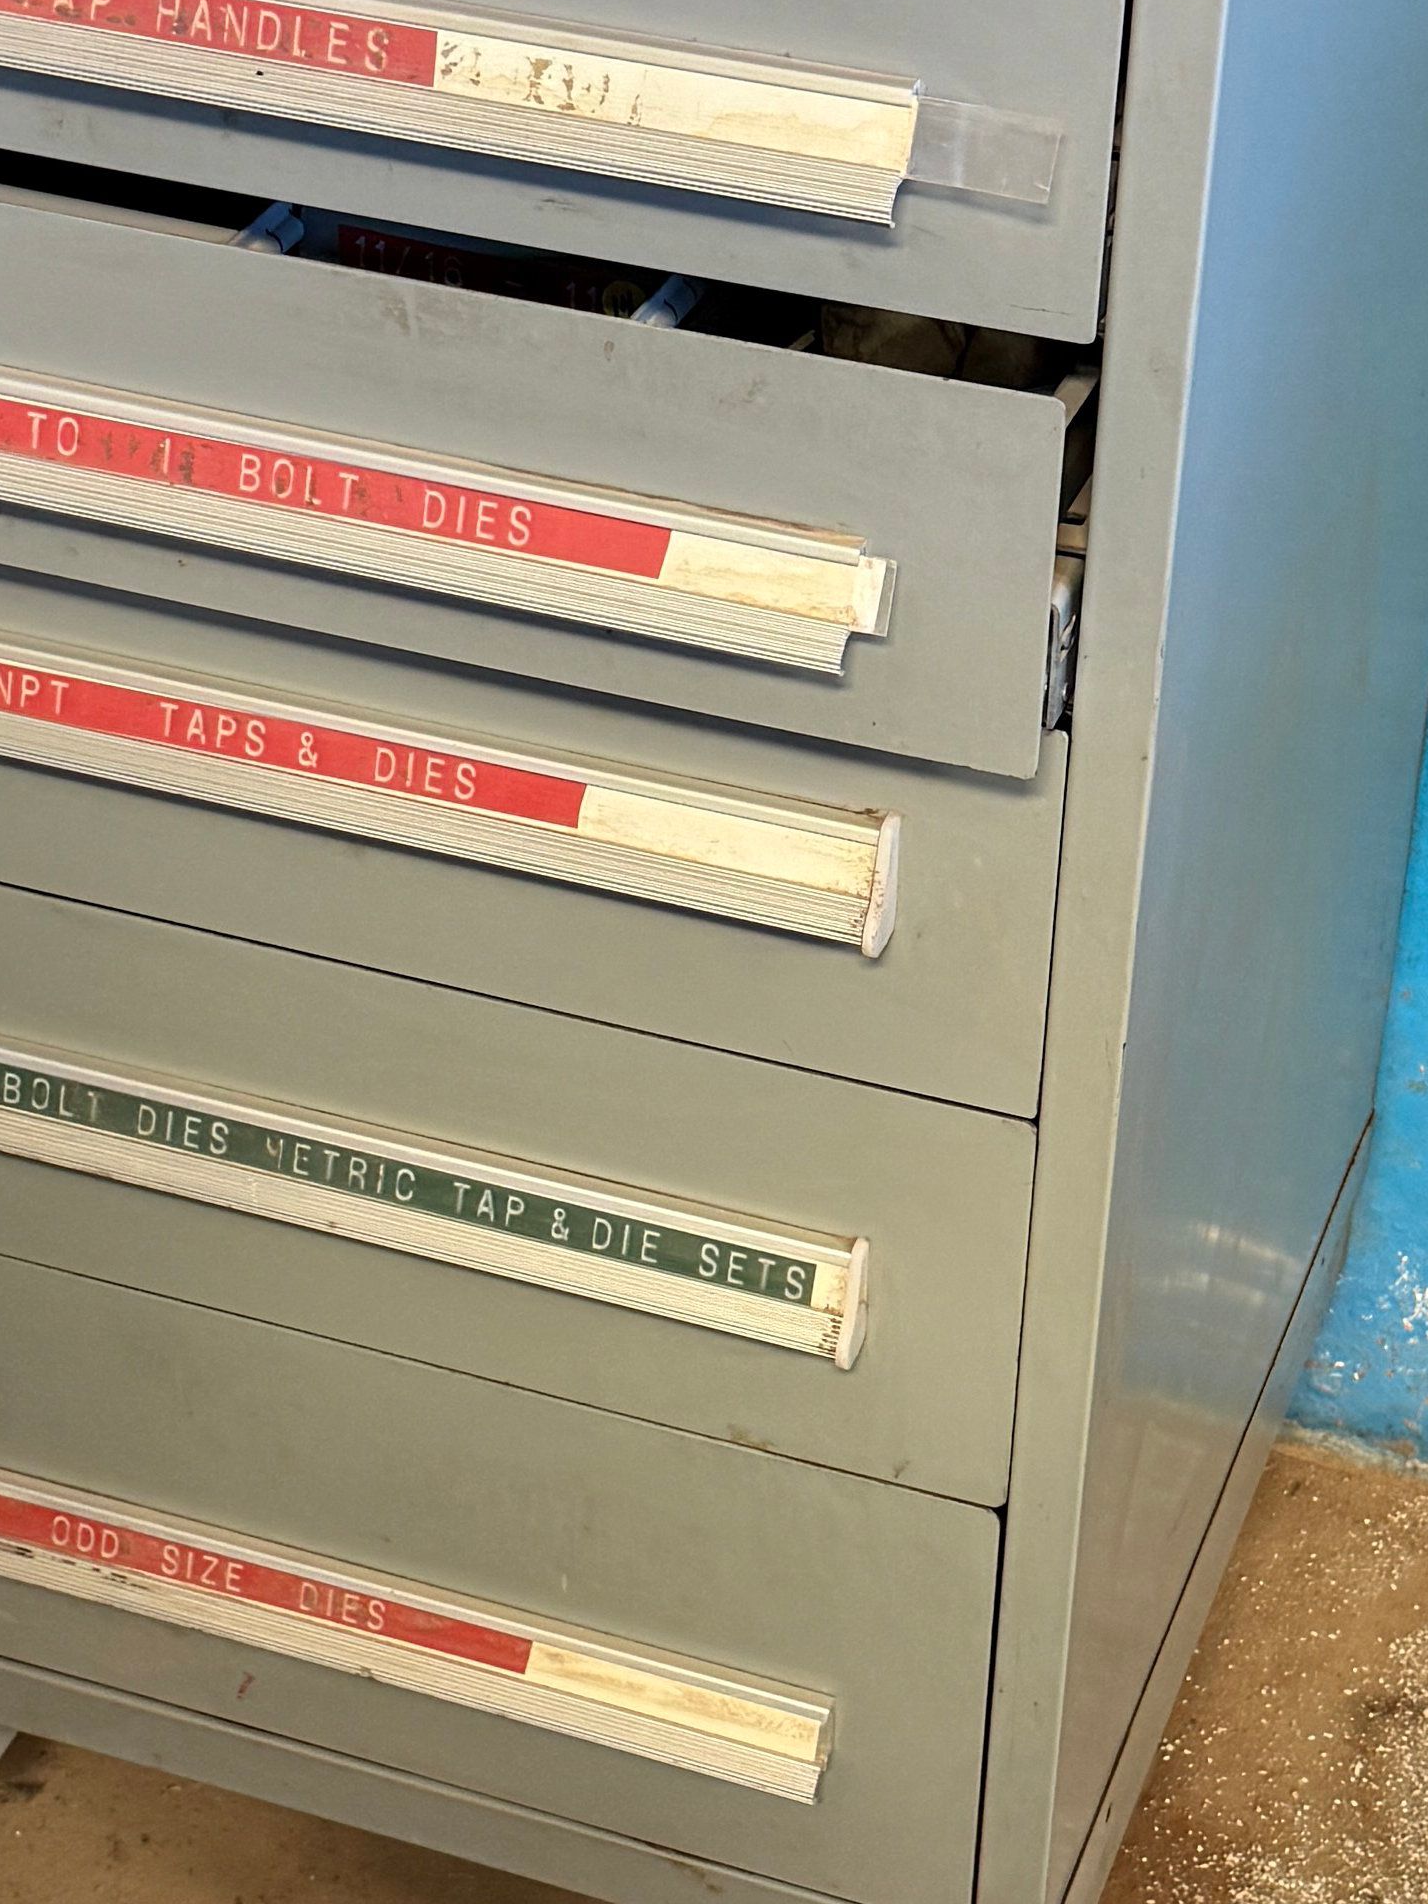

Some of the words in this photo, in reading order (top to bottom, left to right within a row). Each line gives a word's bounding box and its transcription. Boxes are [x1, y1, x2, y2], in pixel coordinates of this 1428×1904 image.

[26, 411, 81, 457] TO
[238, 452, 360, 512] BOLT
[422, 489, 534, 547] DIES
[159, 700, 265, 757] TAPS
[297, 731, 320, 768] &
[374, 746, 477, 800] DIES
[2, 1072, 102, 1122] BOLT
[136, 1103, 229, 1155] DIES
[452, 1181, 526, 1228] TAP
[549, 1207, 570, 1242] &
[591, 1217, 661, 1264] DIE
[698, 1243, 807, 1301] SETS
[50, 1514, 122, 1560] ODD
[160, 1543, 246, 1594] SIZE
[297, 1581, 388, 1631] DIES
